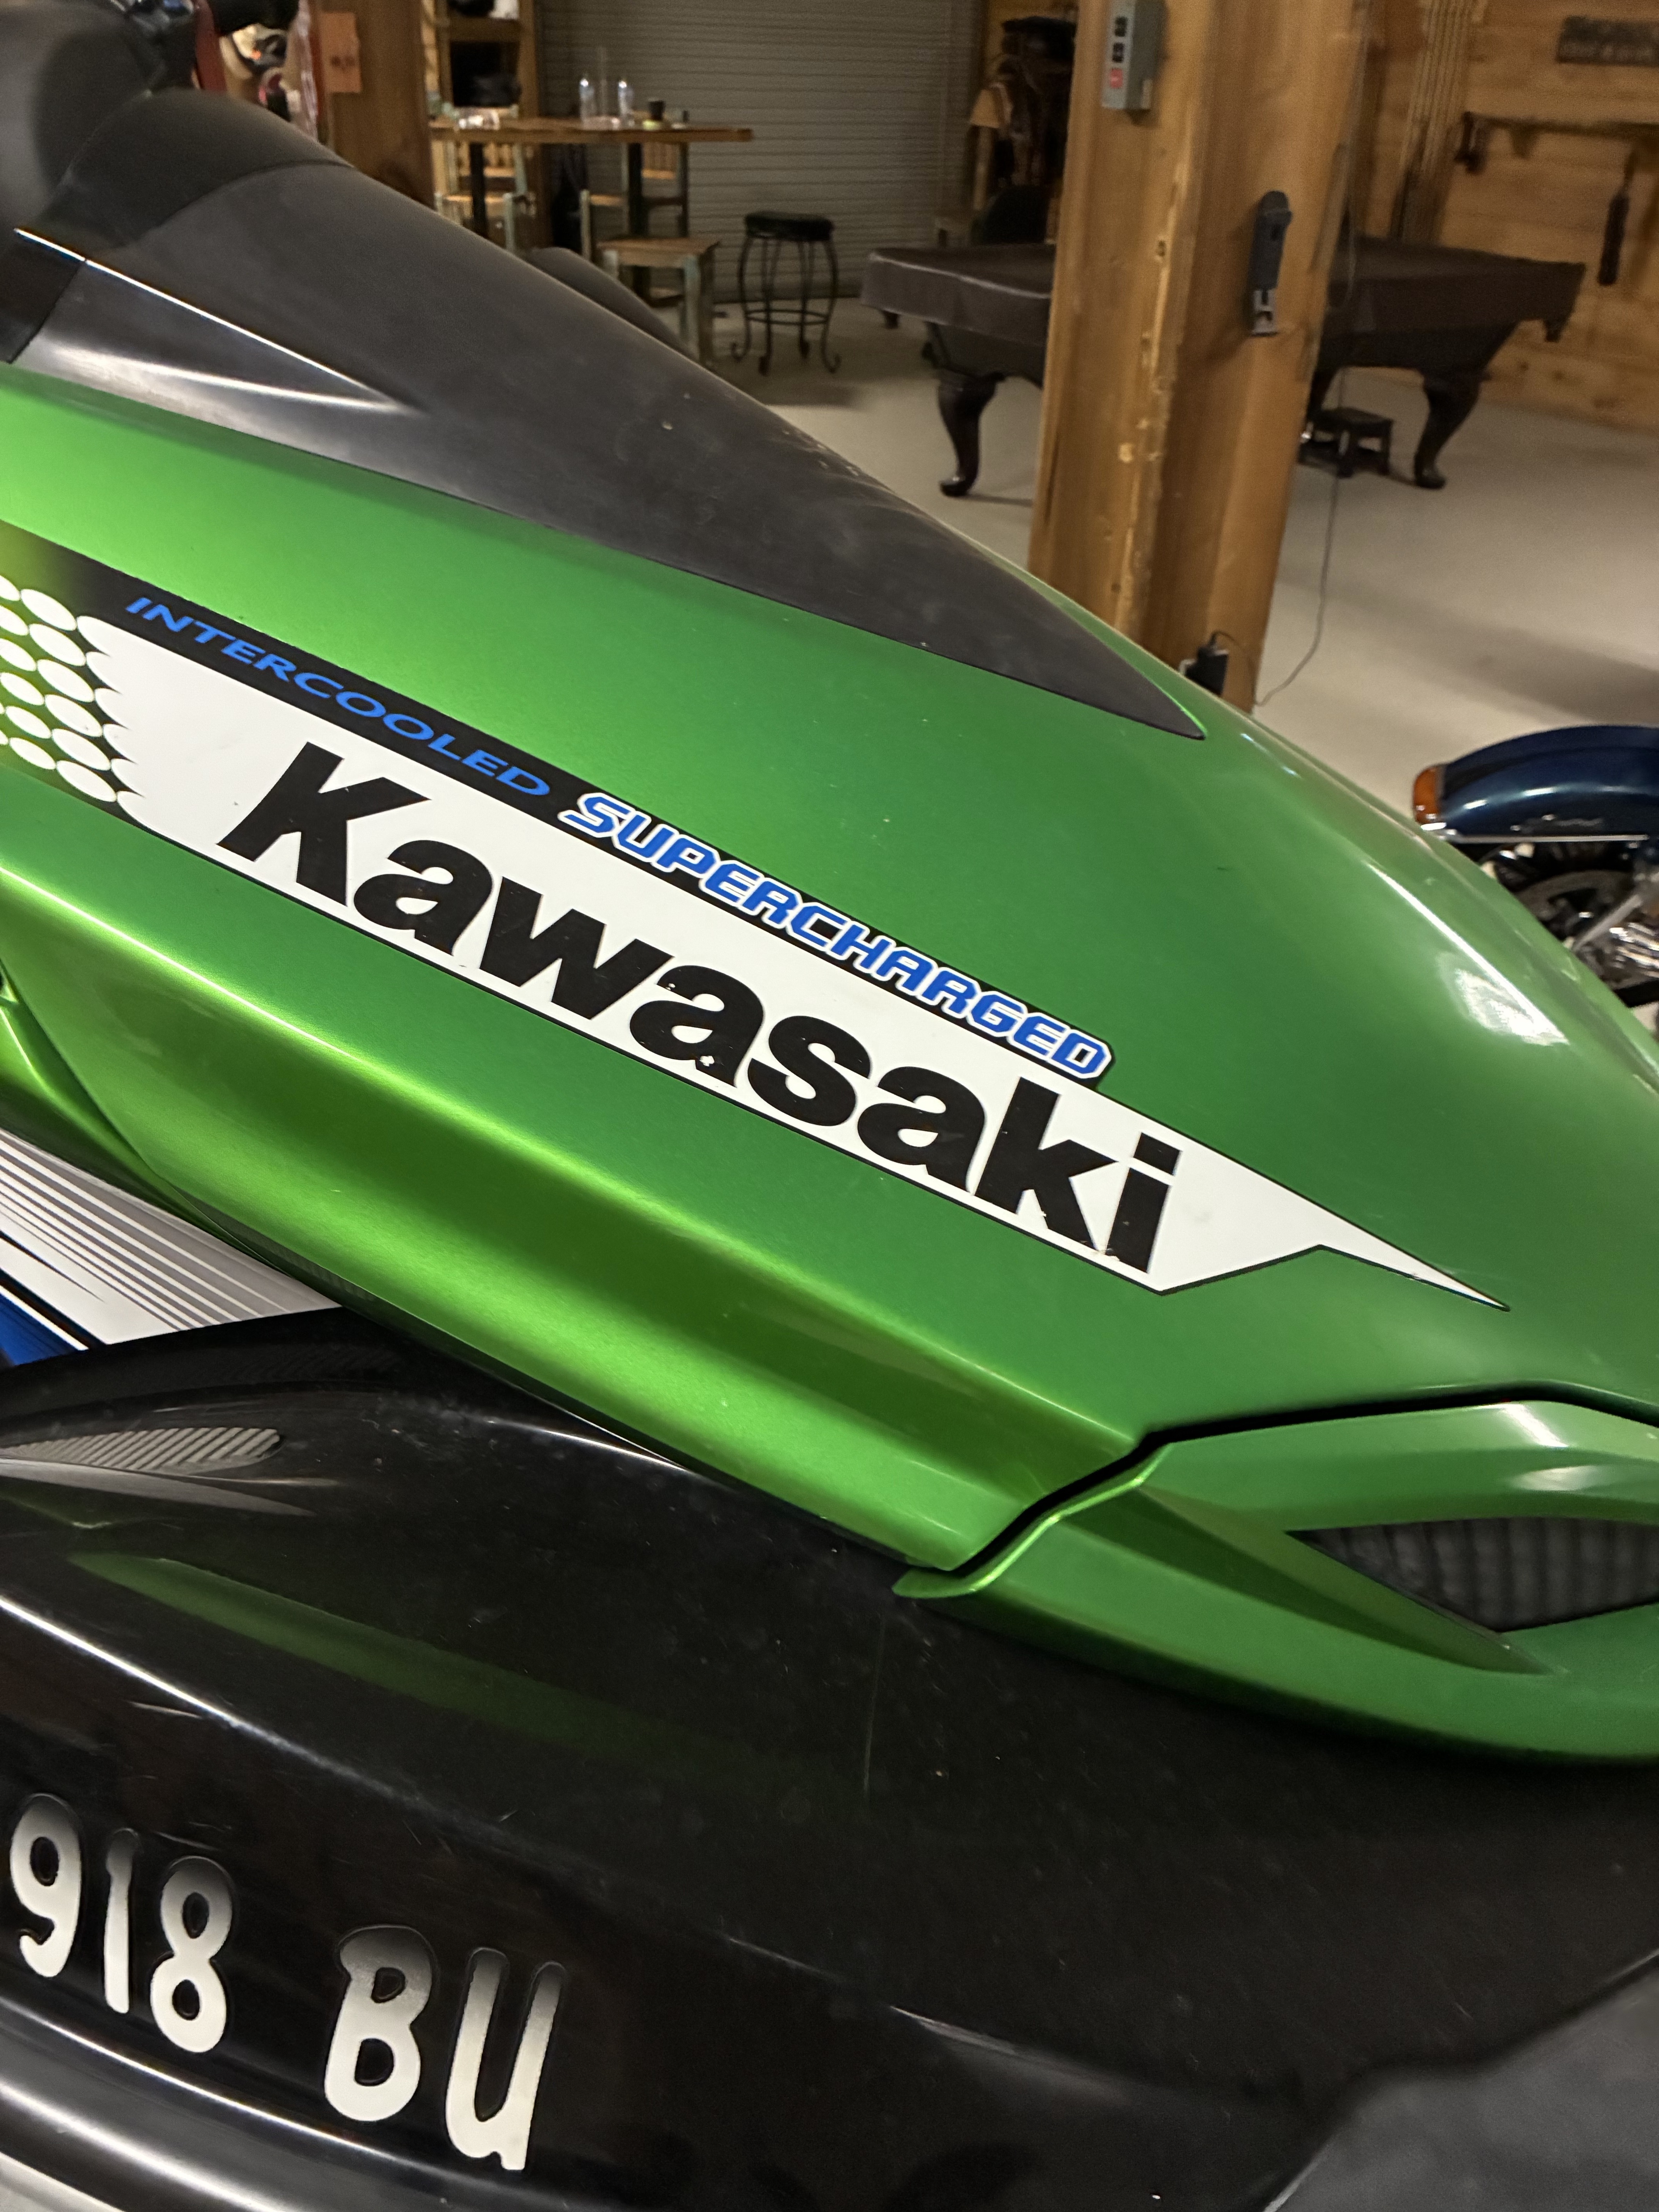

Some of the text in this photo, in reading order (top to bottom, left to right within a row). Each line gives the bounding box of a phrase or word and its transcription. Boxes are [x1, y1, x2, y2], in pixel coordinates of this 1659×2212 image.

[126, 597, 1112, 1078] INTERCOOLED SUPERCHARGED
[216, 742, 1183, 1273] Kawasaki
[10, 1793, 565, 2170] 918 BU
